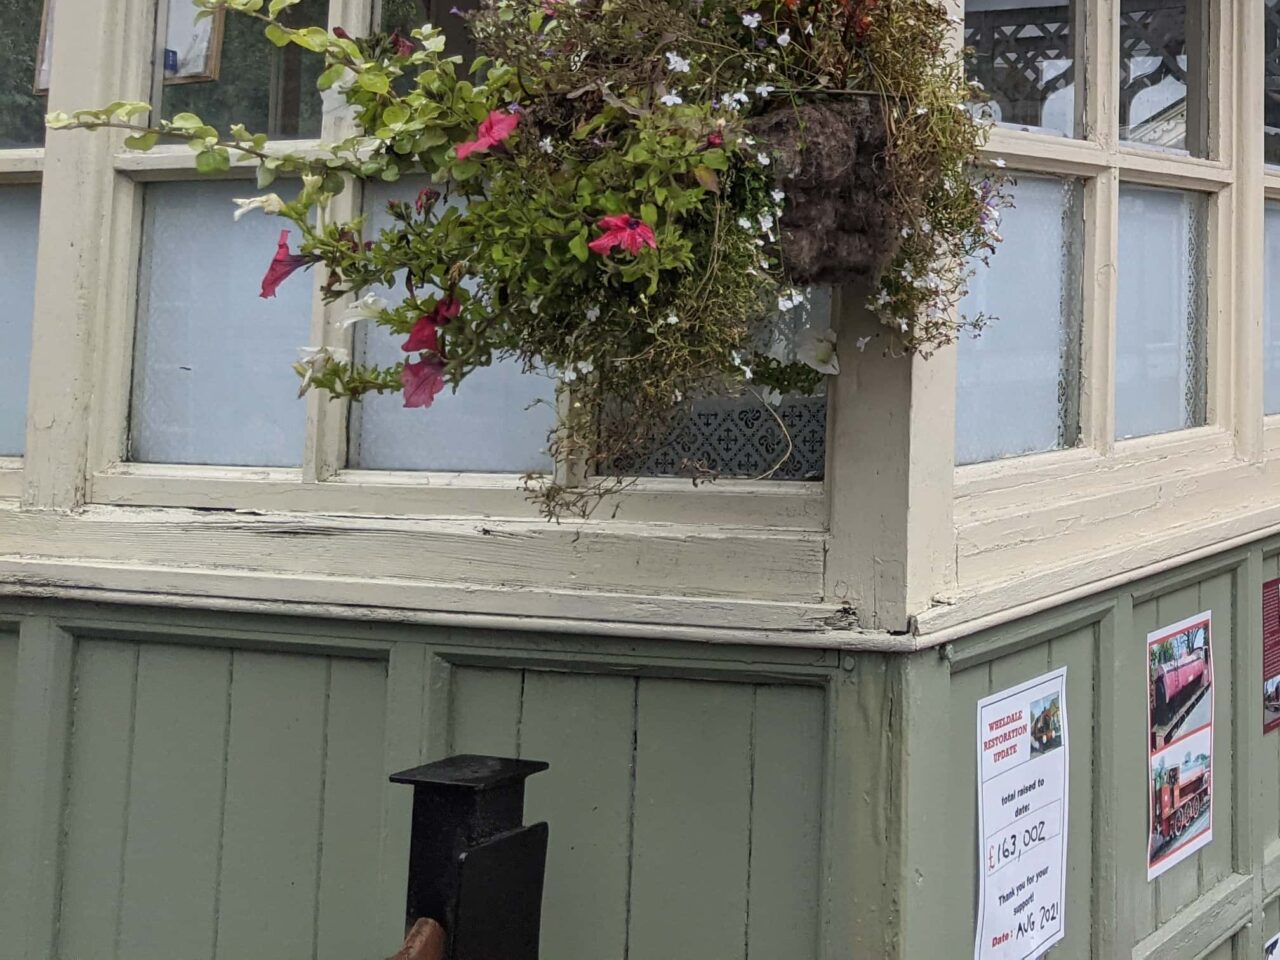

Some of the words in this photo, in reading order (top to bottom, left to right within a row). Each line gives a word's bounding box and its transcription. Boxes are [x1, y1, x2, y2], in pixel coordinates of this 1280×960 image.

[988, 710, 1023, 732] WHELDALE
[983, 723, 1028, 751] RESTORATION
[993, 744, 1018, 763] UPDATE
[1001, 790, 1016, 806] total
[1017, 780, 1037, 797] raised
[1037, 778, 1045, 787] to
[1014, 803, 1030, 817] date:
[998, 887, 1015, 906] Thank
[1016, 881, 1026, 896] you
[1026, 875, 1035, 886] for
[1035, 866, 1049, 883] your
[1013, 892, 1035, 916] support!
[1016, 912, 1035, 940] AUG
[1039, 901, 1059, 929] 2021
